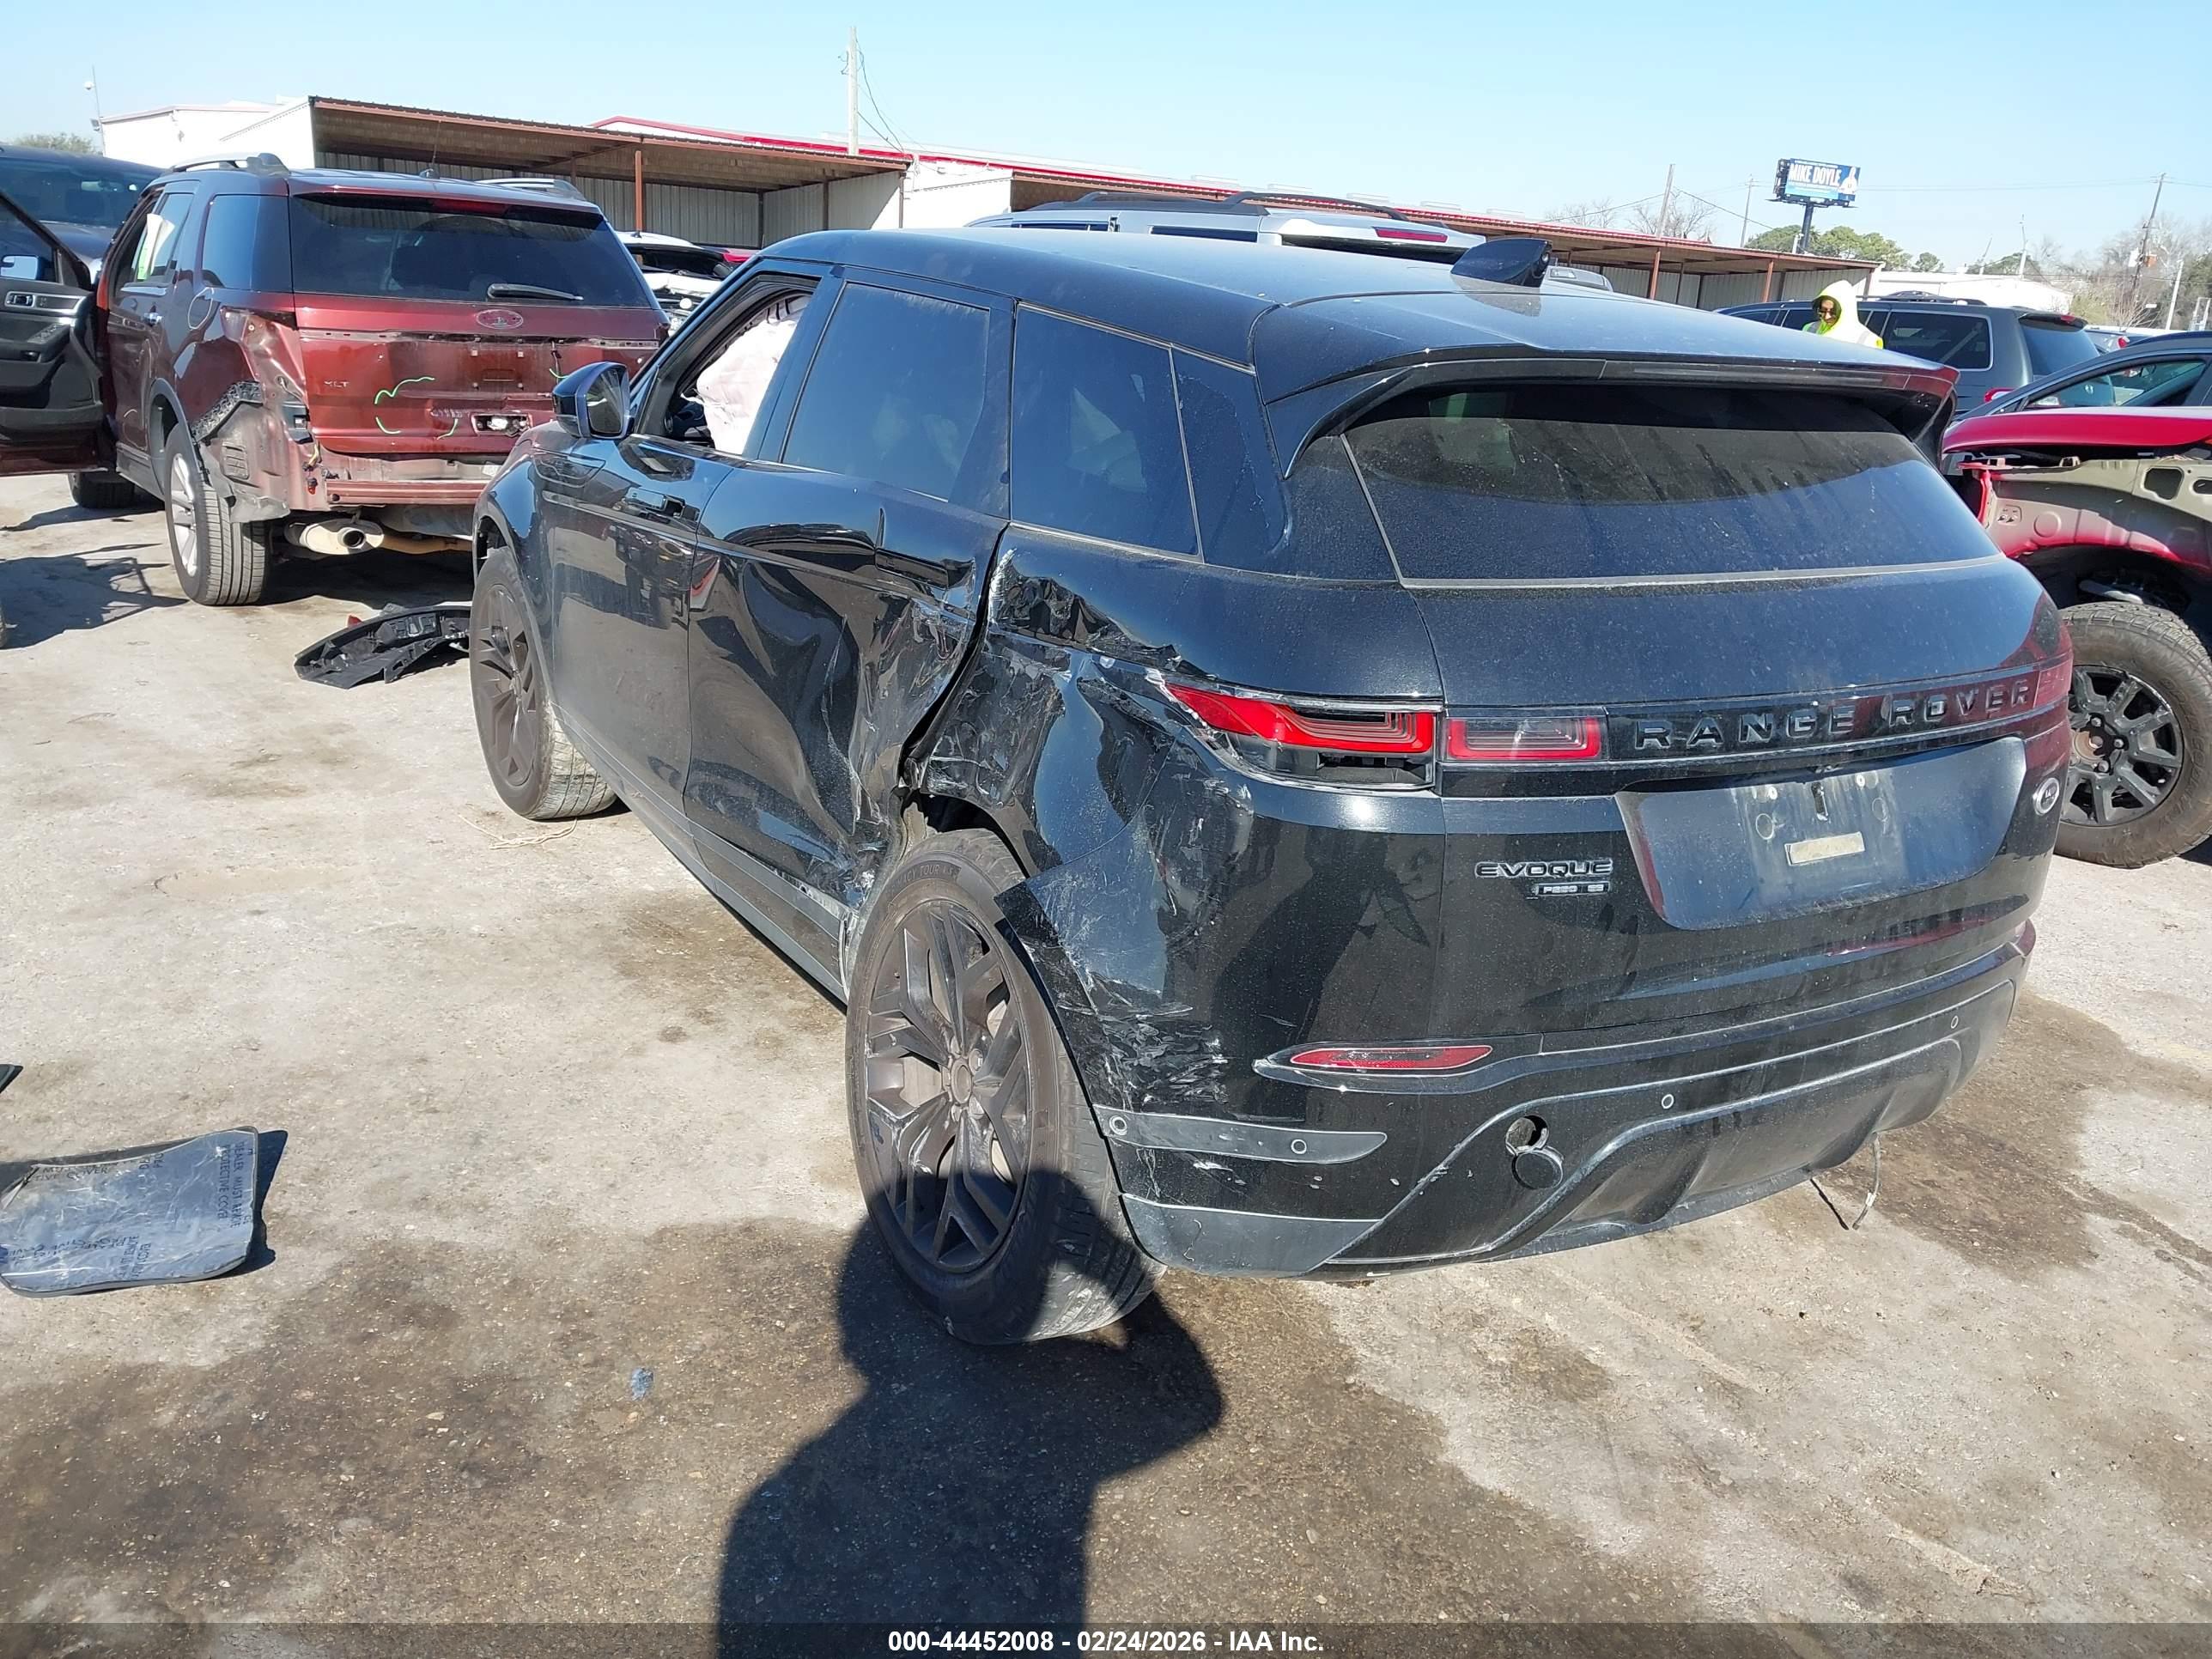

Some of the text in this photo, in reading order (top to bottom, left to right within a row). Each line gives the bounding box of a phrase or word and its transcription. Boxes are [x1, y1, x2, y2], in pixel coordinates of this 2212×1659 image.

[1788, 162, 1813, 183] MIKE
[1813, 167, 1842, 186] DOYLE
[1635, 678, 2029, 750] RANGE ROVER
[1474, 857, 1613, 878] EVOQUE
[217, 1144, 231, 1193] PROTECTIVE
[233, 1141, 245, 1172] DEALER
[231, 1176, 243, 1200] MUST
